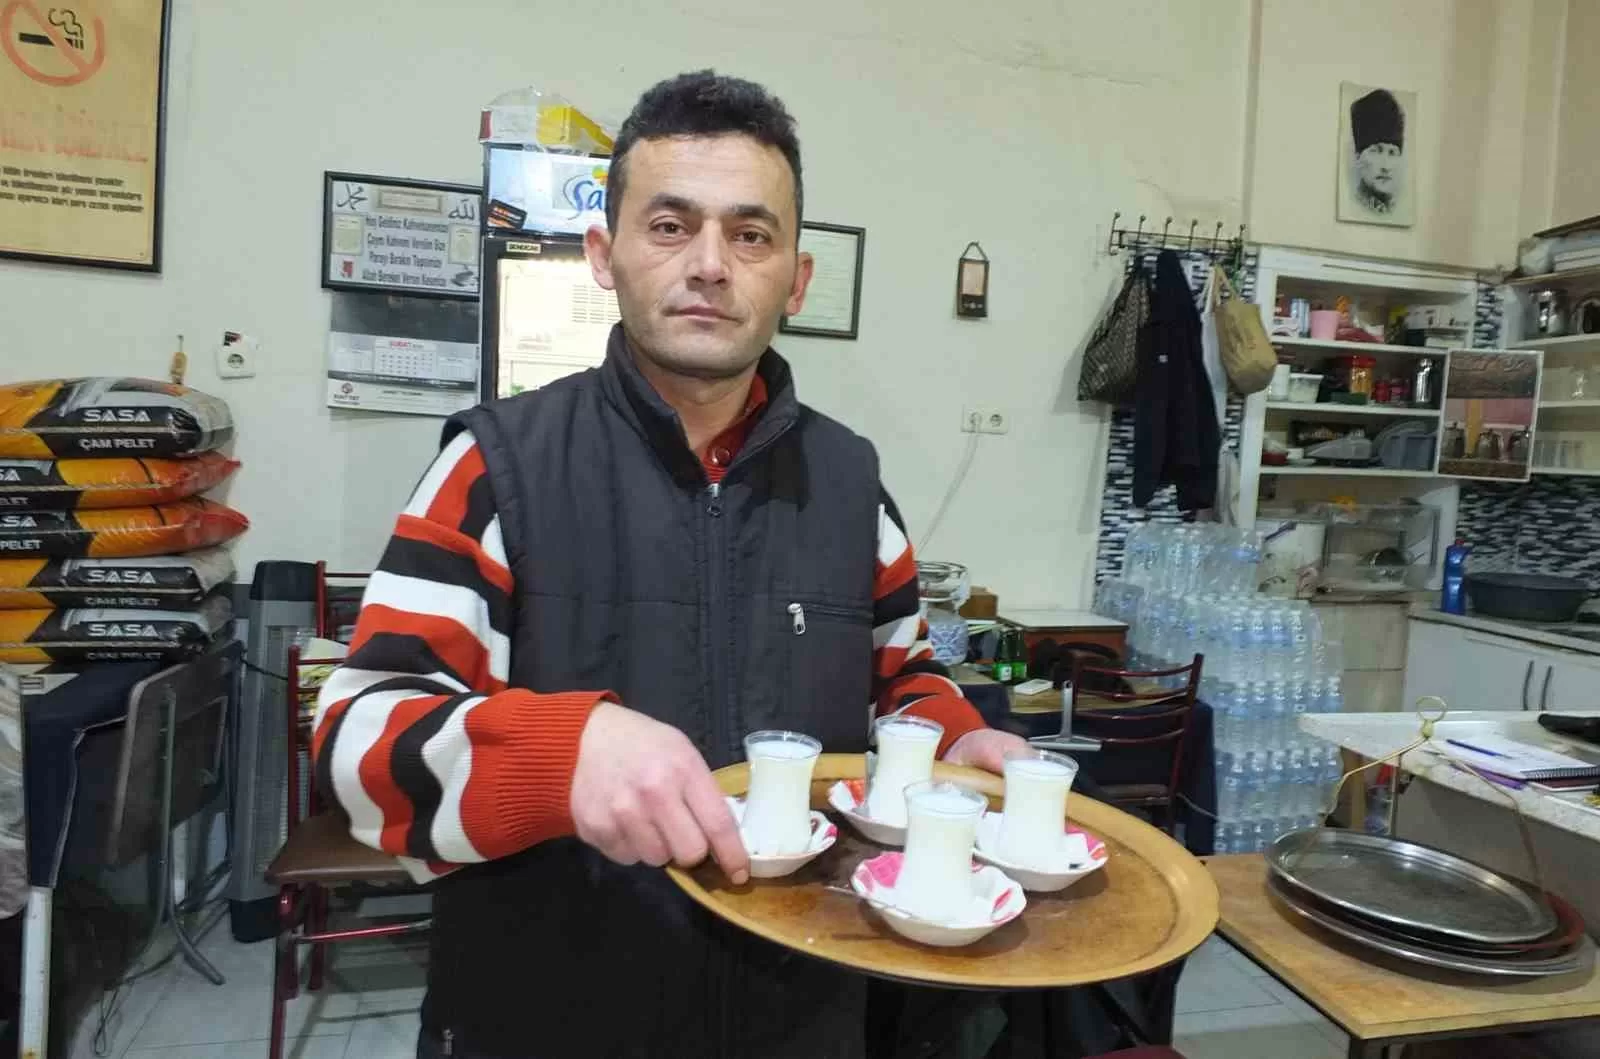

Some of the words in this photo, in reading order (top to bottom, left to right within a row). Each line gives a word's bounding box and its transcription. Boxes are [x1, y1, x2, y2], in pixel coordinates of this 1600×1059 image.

[83, 409, 151, 422] SASA
[80, 438, 112, 451] ÇAM
[113, 438, 157, 448] PELET
[87, 570, 156, 584] SASA
[87, 624, 159, 637] SASA
